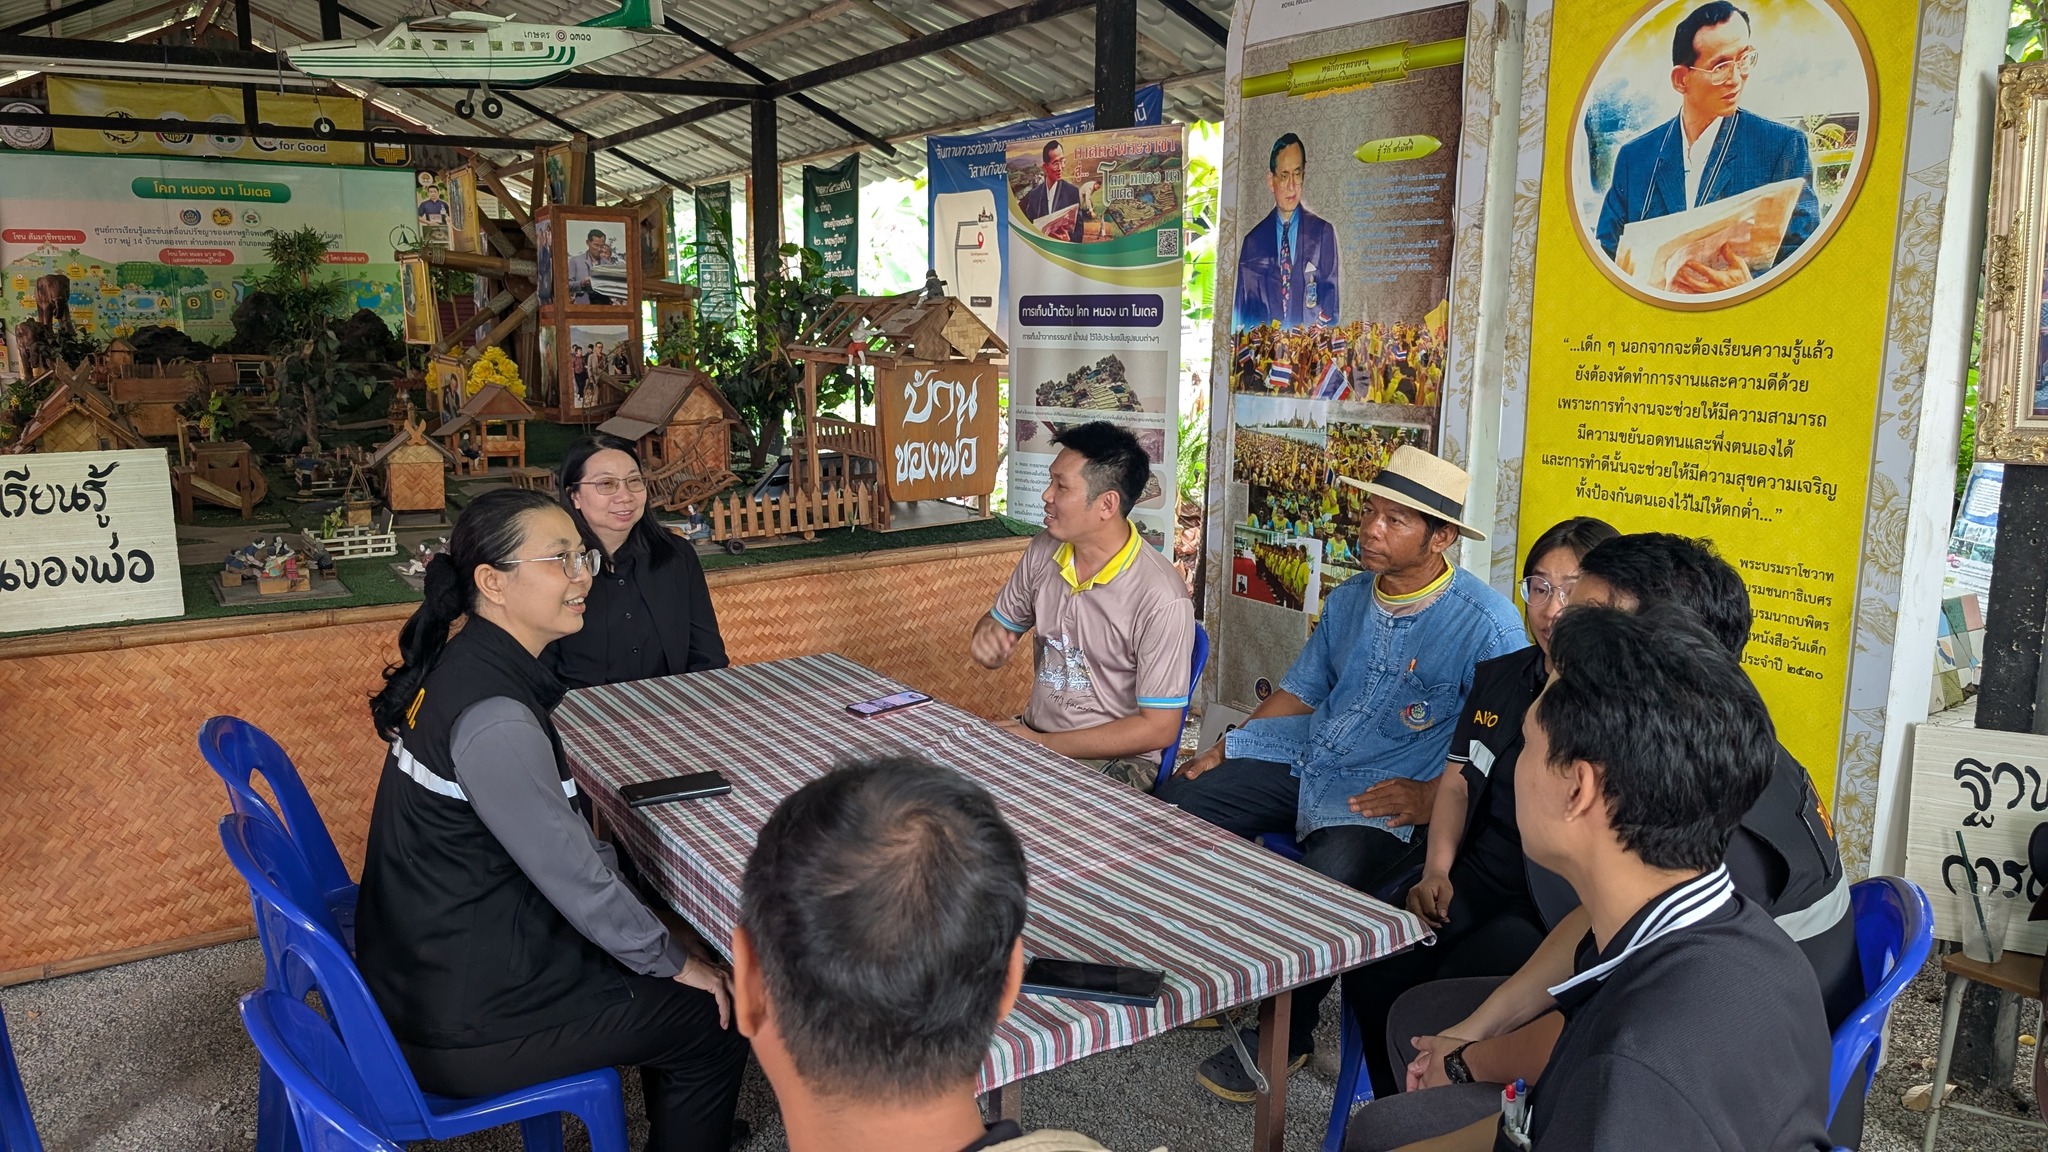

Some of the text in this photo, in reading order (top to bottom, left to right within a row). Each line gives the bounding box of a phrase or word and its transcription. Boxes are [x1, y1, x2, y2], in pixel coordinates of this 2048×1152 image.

[279, 141, 295, 150] for
[297, 142, 326, 153] Good
[153, 181, 272, 198] โคก หนอง นา โมเดล
[120, 236, 132, 247] หมู่
[145, 236, 188, 246] บ้านคลองหก
[160, 299, 198, 307] A B
[214, 290, 223, 299] C
[1022, 302, 1158, 317] การเก็บน้ำด้วย โคก หนอง นา โมเดล
[1621, 337, 1835, 365] นอกจากจะต้องเรียนความรู้แล้ว
[1575, 364, 1810, 393] ยังต้องหัดทำการงานและความดีด้วย
[902, 369, 984, 426] บ้าน
[1557, 396, 1828, 428] เพราะการทำงานจะช่วยให้มีความสามารถ
[894, 415, 980, 487] ของพ่อ
[1577, 423, 1794, 459] มีความขยันอดทนและพึ่งตนเองได้
[1541, 450, 1839, 502] และการทำดีนั้นจะช่วยให้มีความสุขความเจริญ
[1739, 558, 1834, 582] พระบรมราโชวาท
[1743, 583, 1833, 607] บรมชนกาธิเบศร
[1740, 652, 1824, 680] ประจำปี ๒๕๓๐
[1942, 854, 2043, 904] การ
